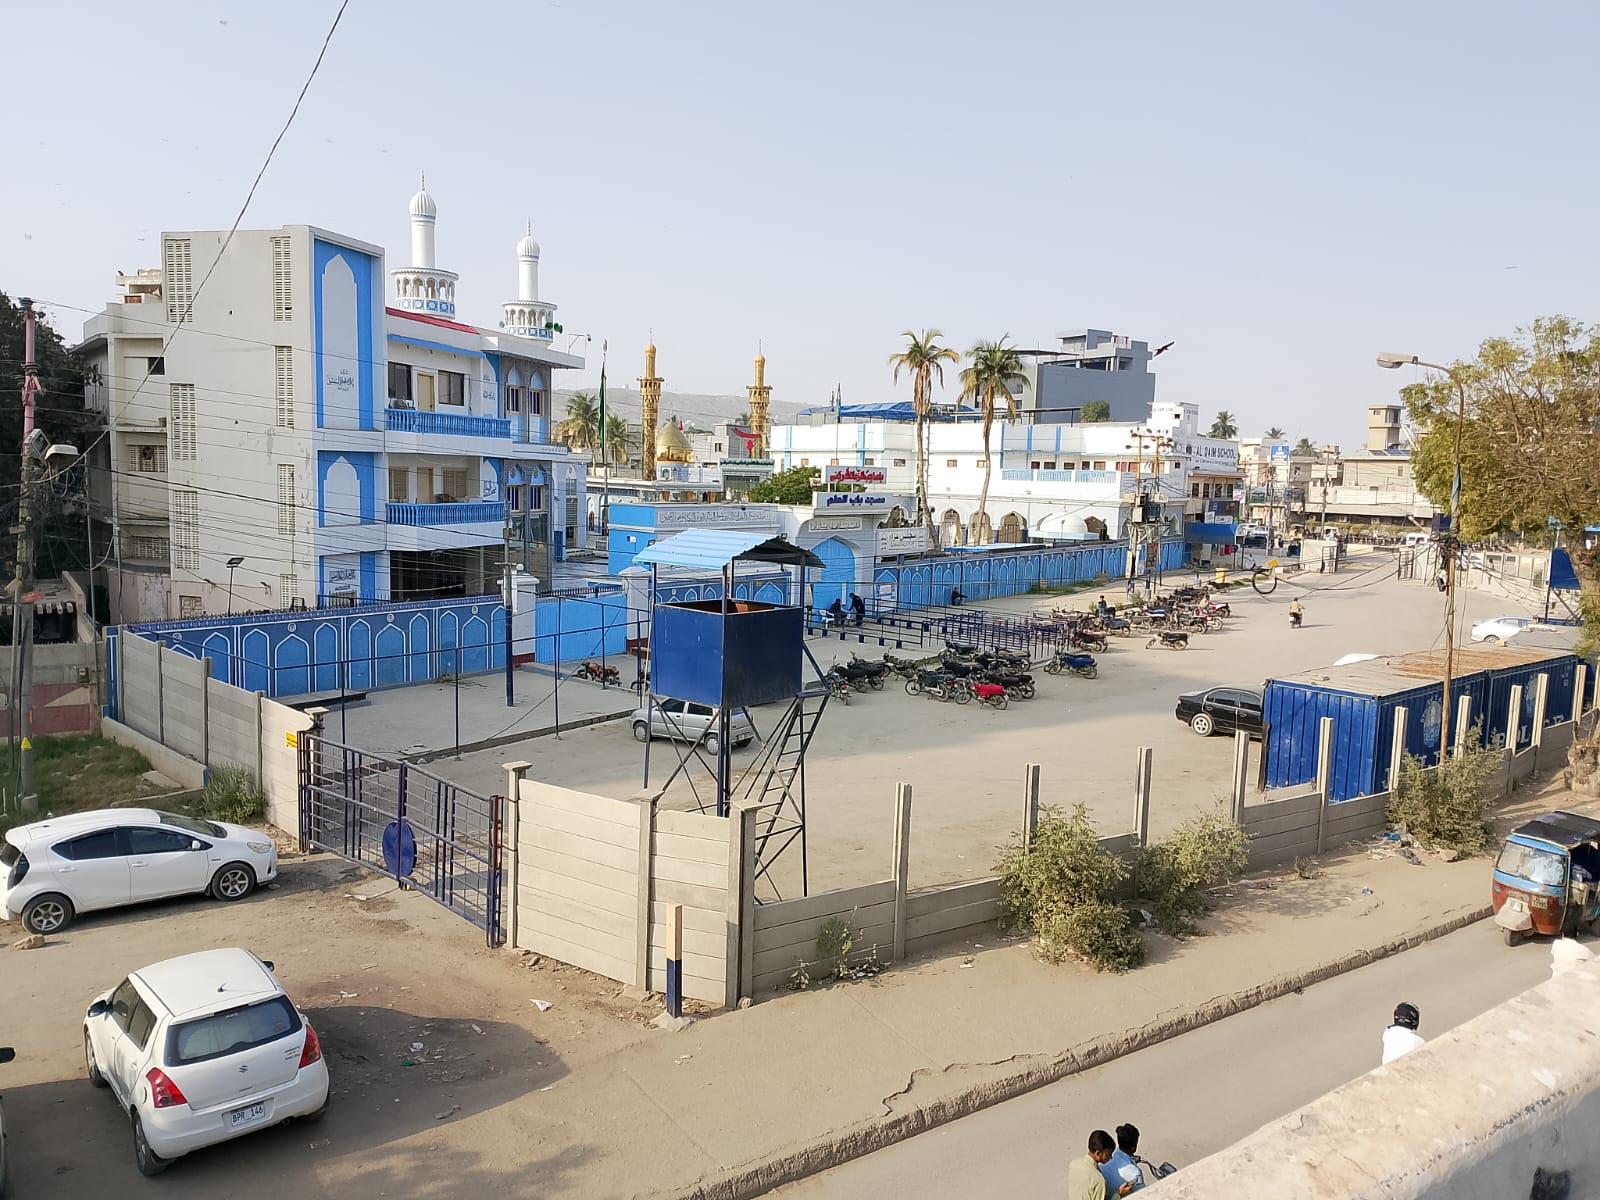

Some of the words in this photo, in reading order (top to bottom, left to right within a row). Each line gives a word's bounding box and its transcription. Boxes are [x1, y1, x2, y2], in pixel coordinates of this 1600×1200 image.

[1217, 448, 1236, 459] SCHOOL
[827, 494, 848, 507] العلم
[849, 495, 863, 506] باب
[865, 497, 886, 506] مسجد
[233, 1112, 245, 1122] BPR
[251, 1106, 263, 1117] 146
